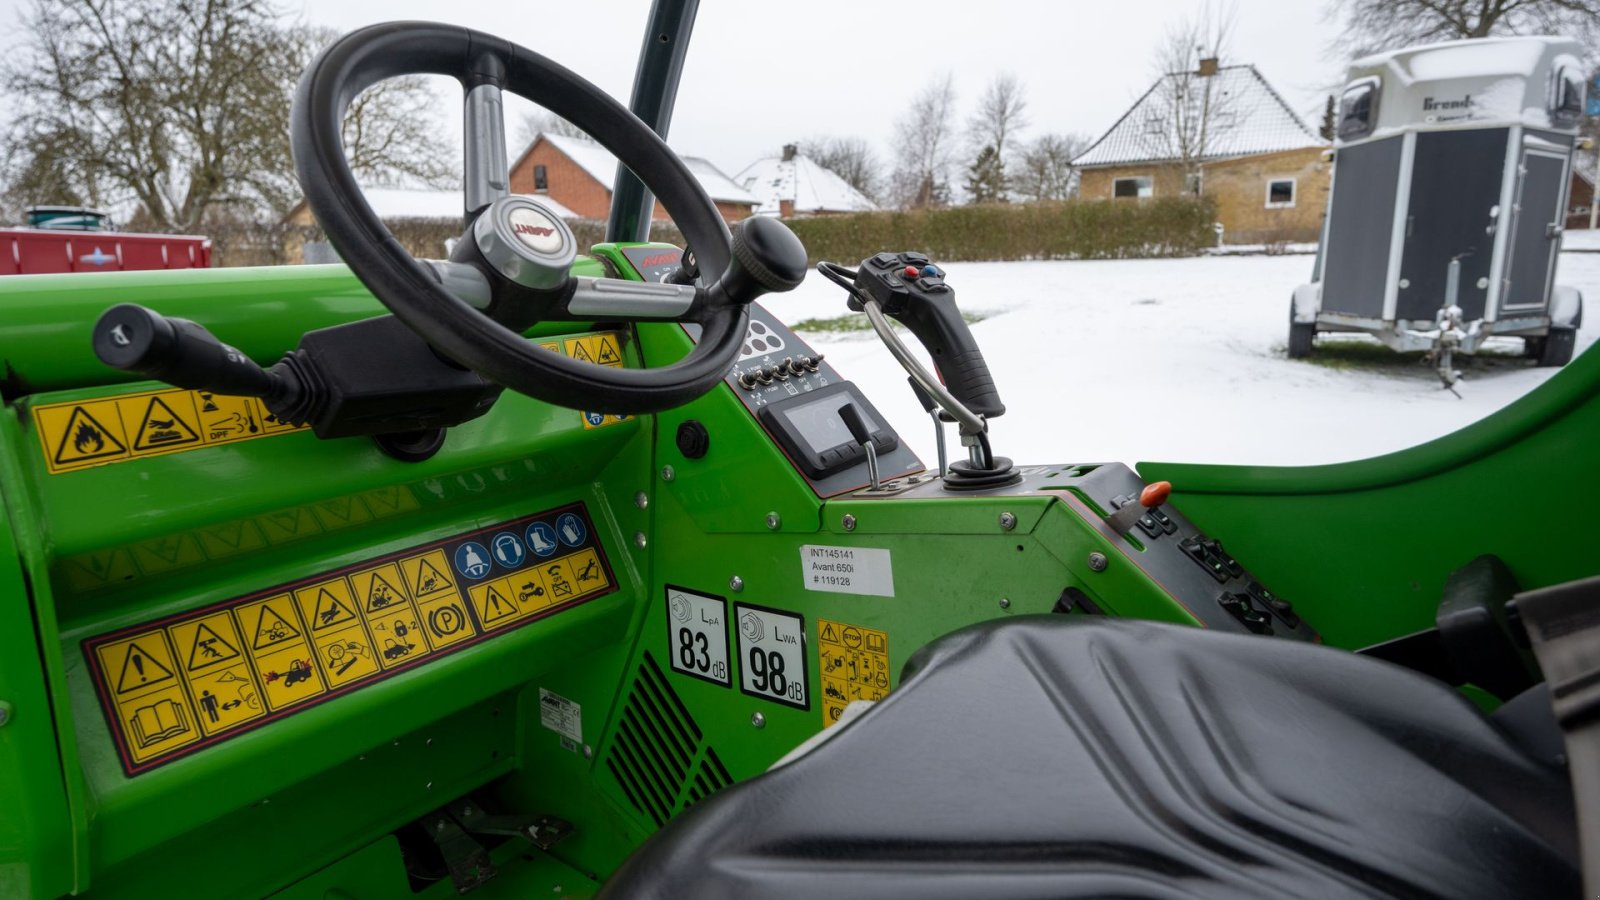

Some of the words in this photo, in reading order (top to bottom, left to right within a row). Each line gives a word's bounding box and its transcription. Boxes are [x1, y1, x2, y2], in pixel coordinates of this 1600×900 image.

[209, 430, 229, 440] DPF
[810, 548, 854, 559] INT145141
[812, 562, 835, 572] Avant
[836, 563, 854, 573] 650i
[814, 575, 820, 583] #
[821, 576, 851, 586] 119128
[679, 627, 711, 673] 83
[712, 660, 726, 679] dB
[750, 646, 787, 697] 98
[788, 681, 803, 701] dB
